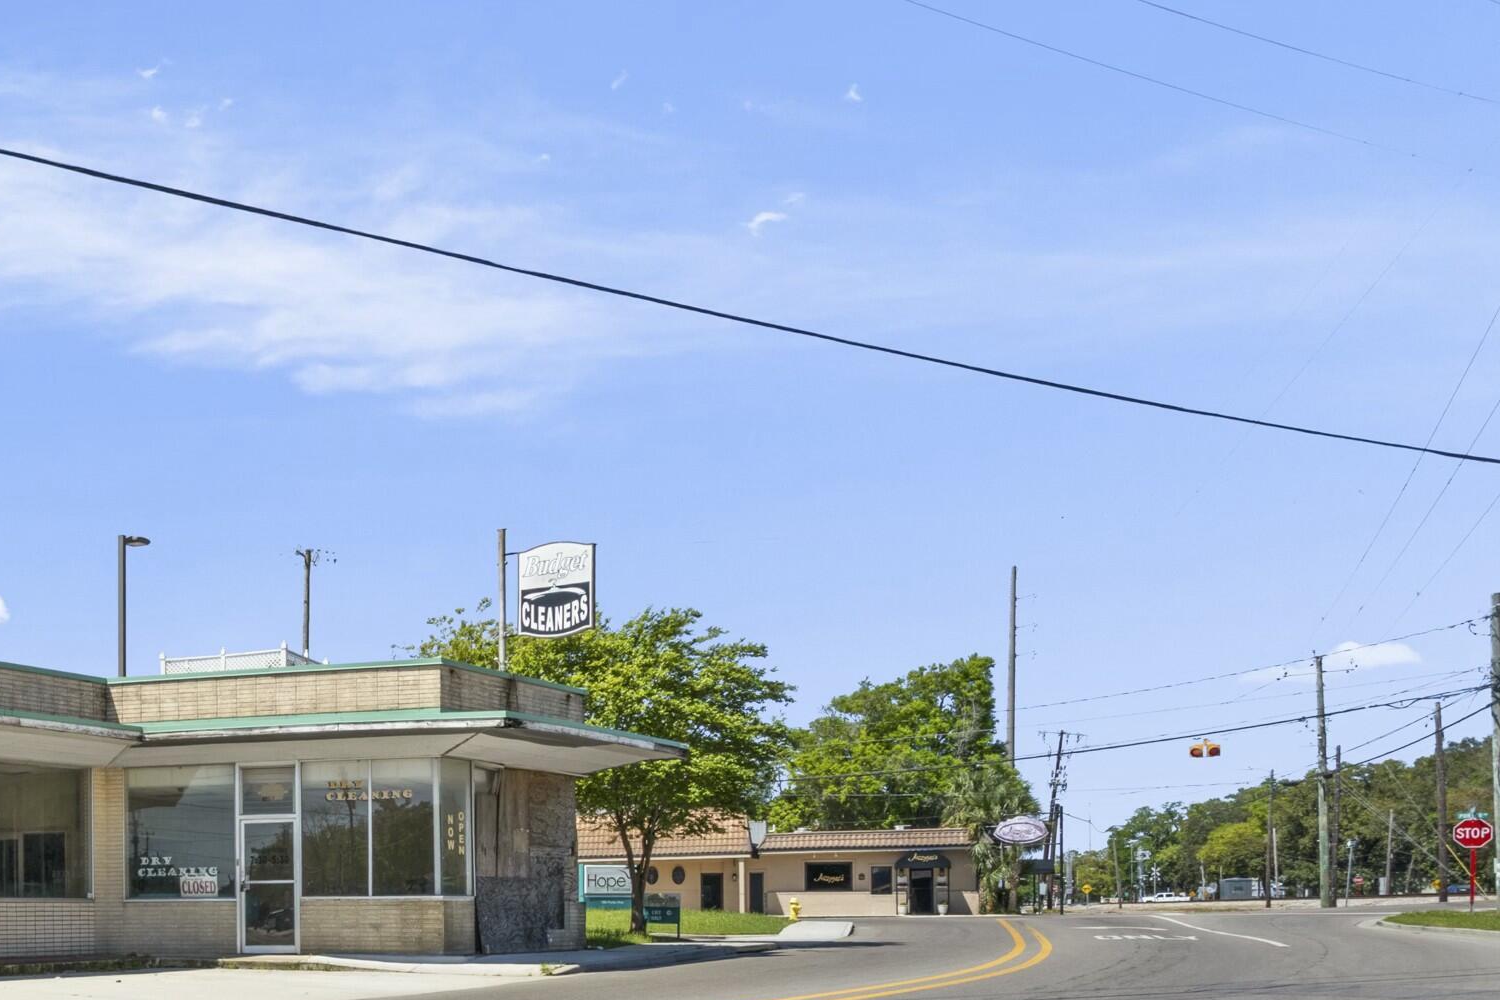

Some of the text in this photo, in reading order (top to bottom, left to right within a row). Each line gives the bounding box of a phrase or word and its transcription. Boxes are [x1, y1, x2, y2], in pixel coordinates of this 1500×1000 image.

[522, 549, 589, 579] Budget
[522, 594, 588, 631] CLEANERS
[325, 789, 413, 801] CLEANING
[447, 814, 455, 850] NOW
[1456, 827, 1490, 839] STOP
[140, 856, 172, 865] DRY
[137, 866, 218, 877] CLEANING
[181, 880, 217, 894] CLOSED
[587, 873, 627, 892] Hope
